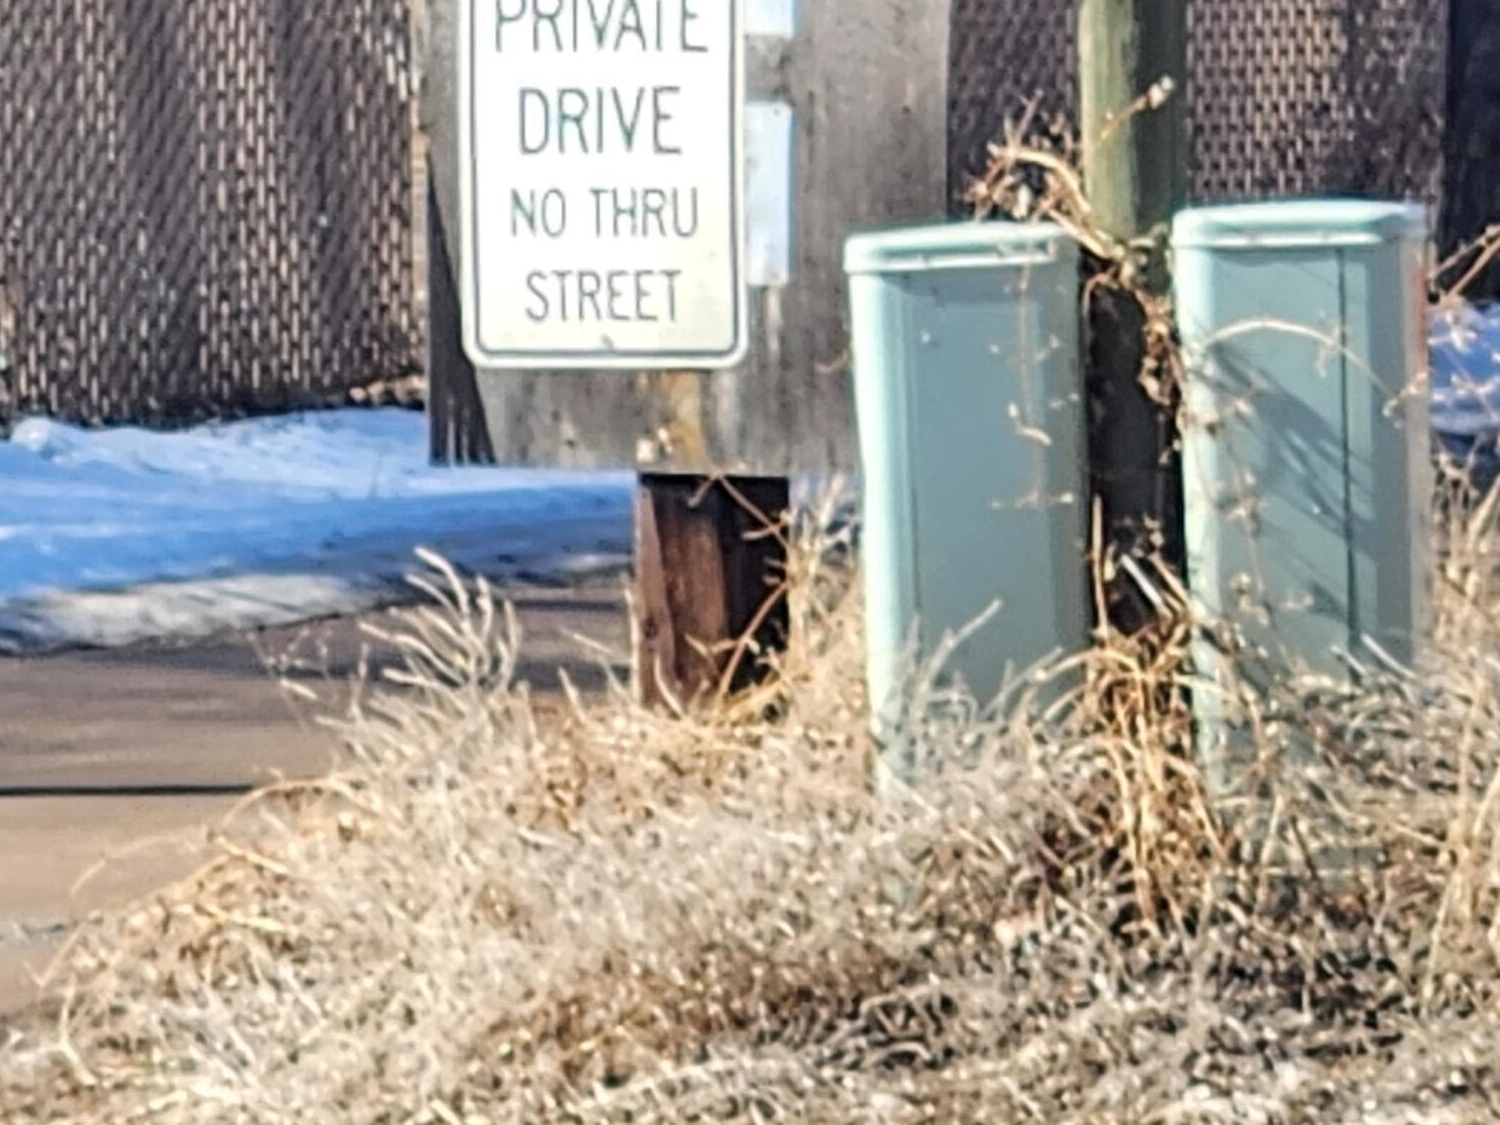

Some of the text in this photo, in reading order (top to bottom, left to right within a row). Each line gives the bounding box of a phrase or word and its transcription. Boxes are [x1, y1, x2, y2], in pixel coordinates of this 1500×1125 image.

[518, 85, 682, 155] DRIVE
[510, 187, 698, 238] NO THRU
[525, 270, 682, 323] STREET
